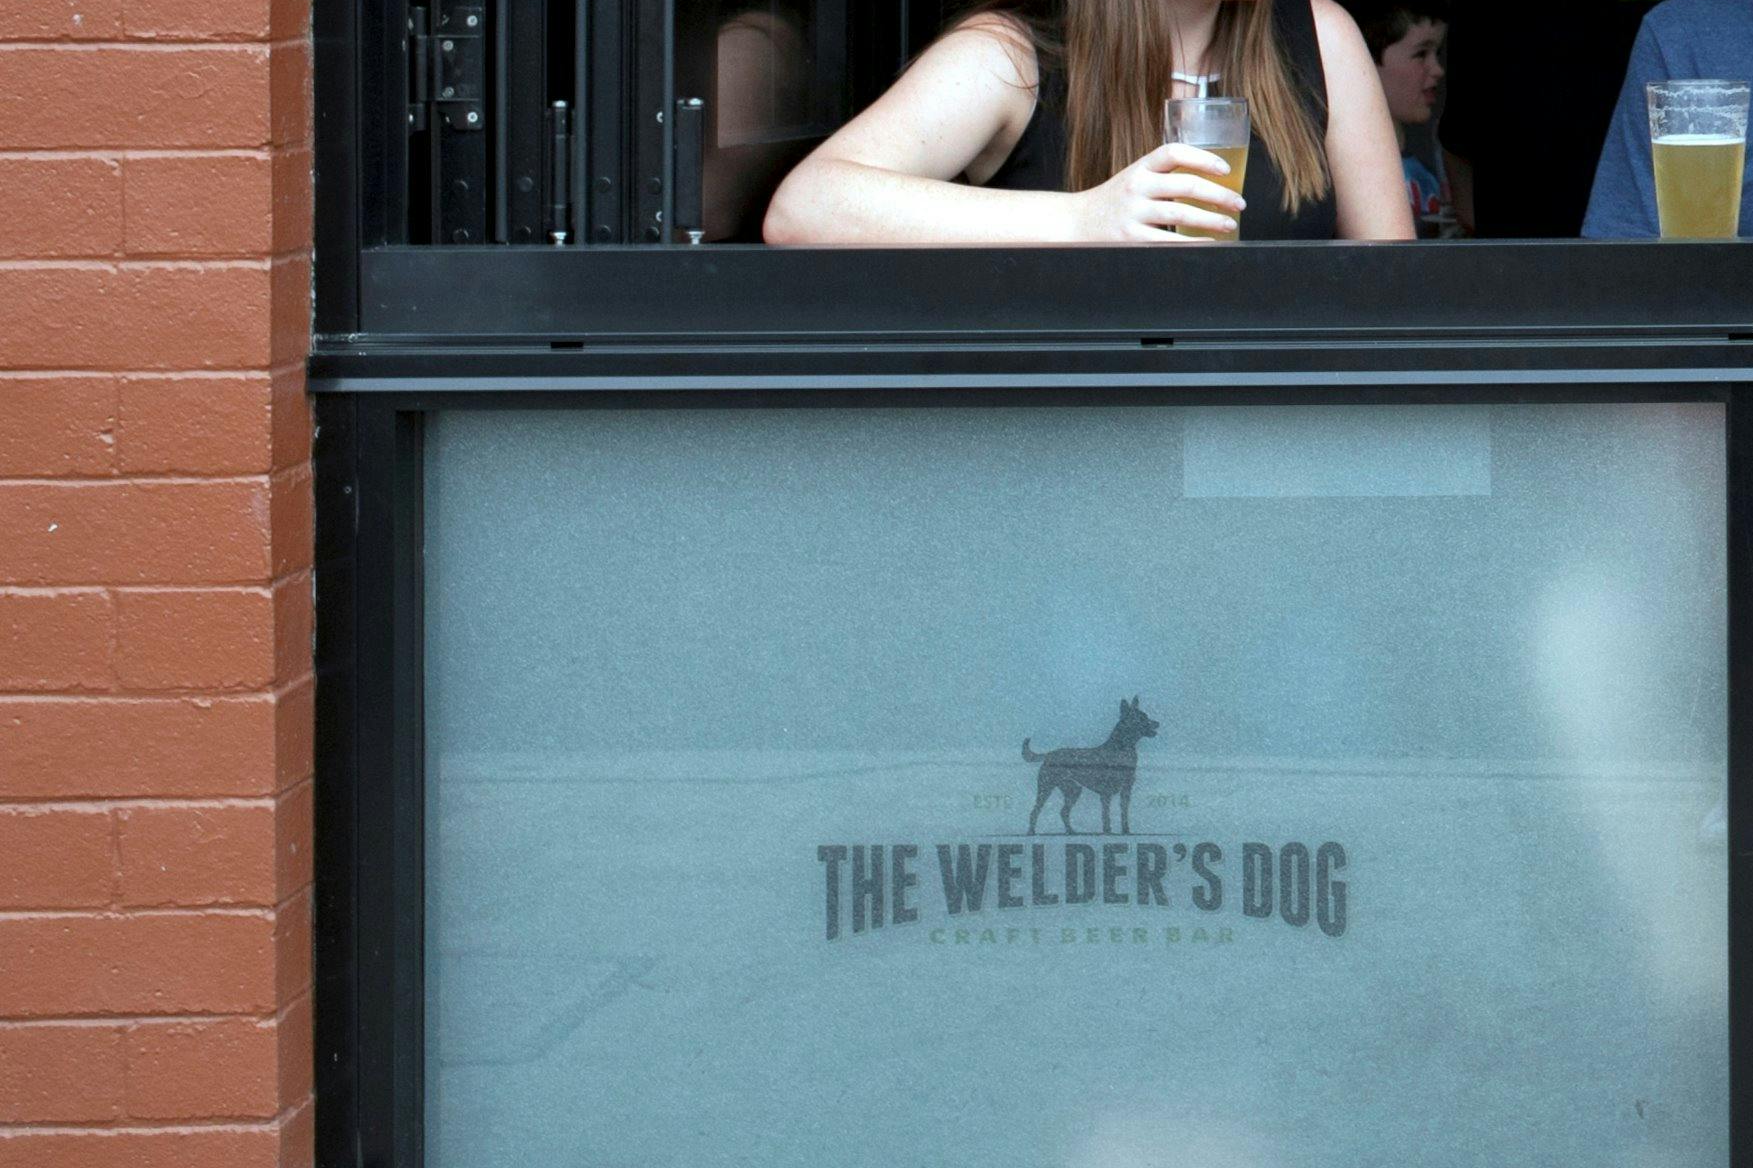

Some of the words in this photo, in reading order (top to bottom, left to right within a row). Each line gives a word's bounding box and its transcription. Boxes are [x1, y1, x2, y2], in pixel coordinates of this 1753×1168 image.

[817, 844, 919, 941] THE
[936, 842, 1224, 915] WELDER'S
[1242, 841, 1348, 936] DOG
[929, 928, 1041, 944] CRAFT
[1060, 928, 1149, 944] BEER
[1165, 928, 1236, 944] BAR
